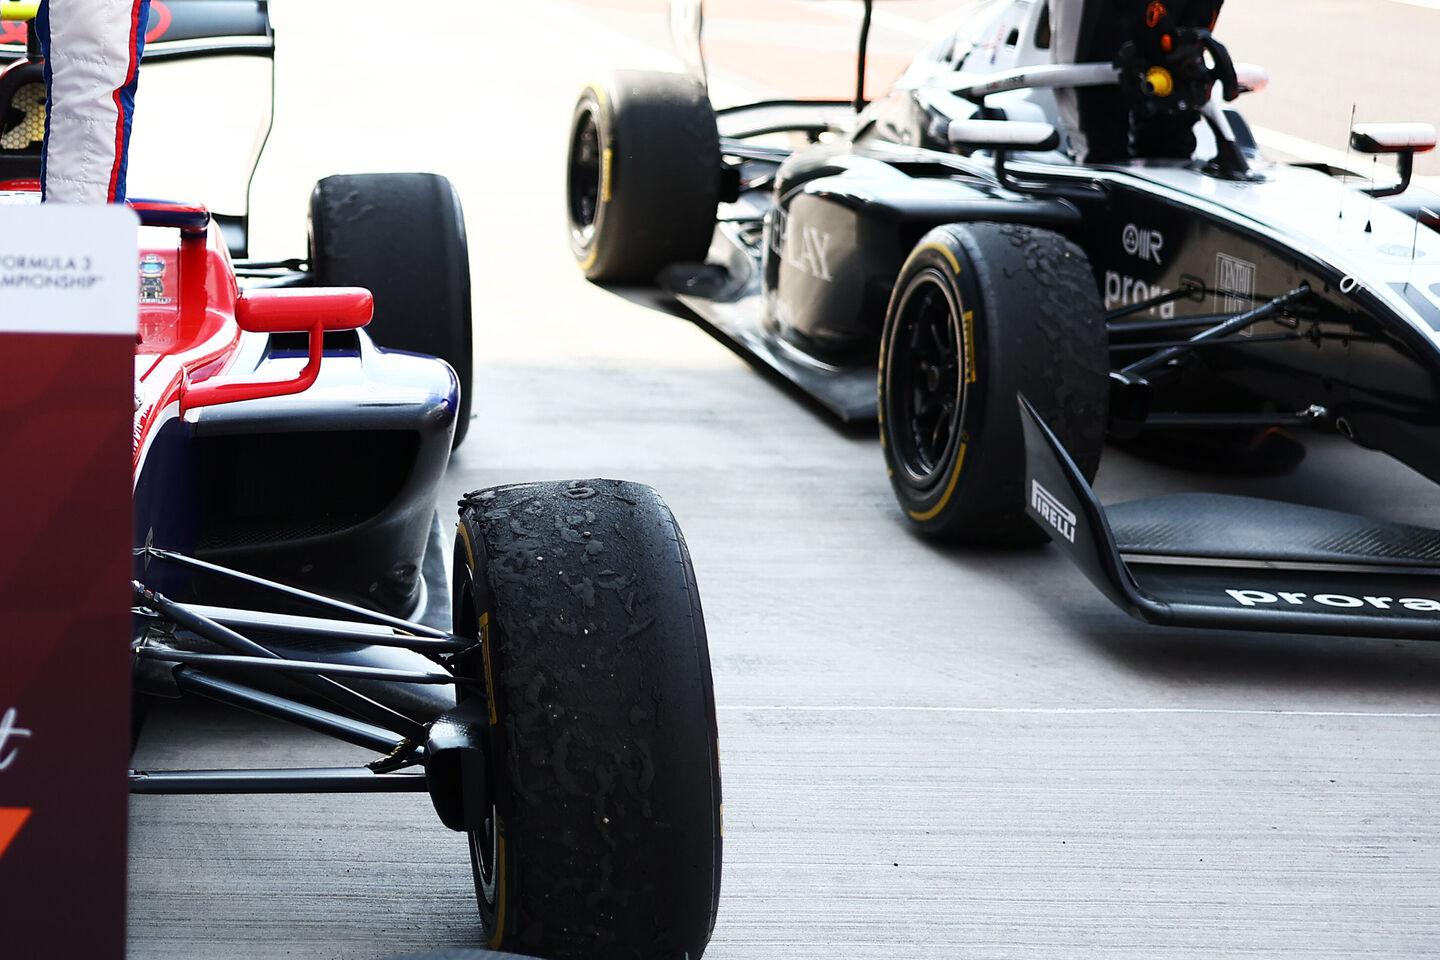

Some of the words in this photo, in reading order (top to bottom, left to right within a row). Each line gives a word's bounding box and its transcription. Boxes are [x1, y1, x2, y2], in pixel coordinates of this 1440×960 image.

[82, 257, 92, 270] 3
[1031, 478, 1077, 544] PIRELLI
[1225, 589, 1440, 612] prora
